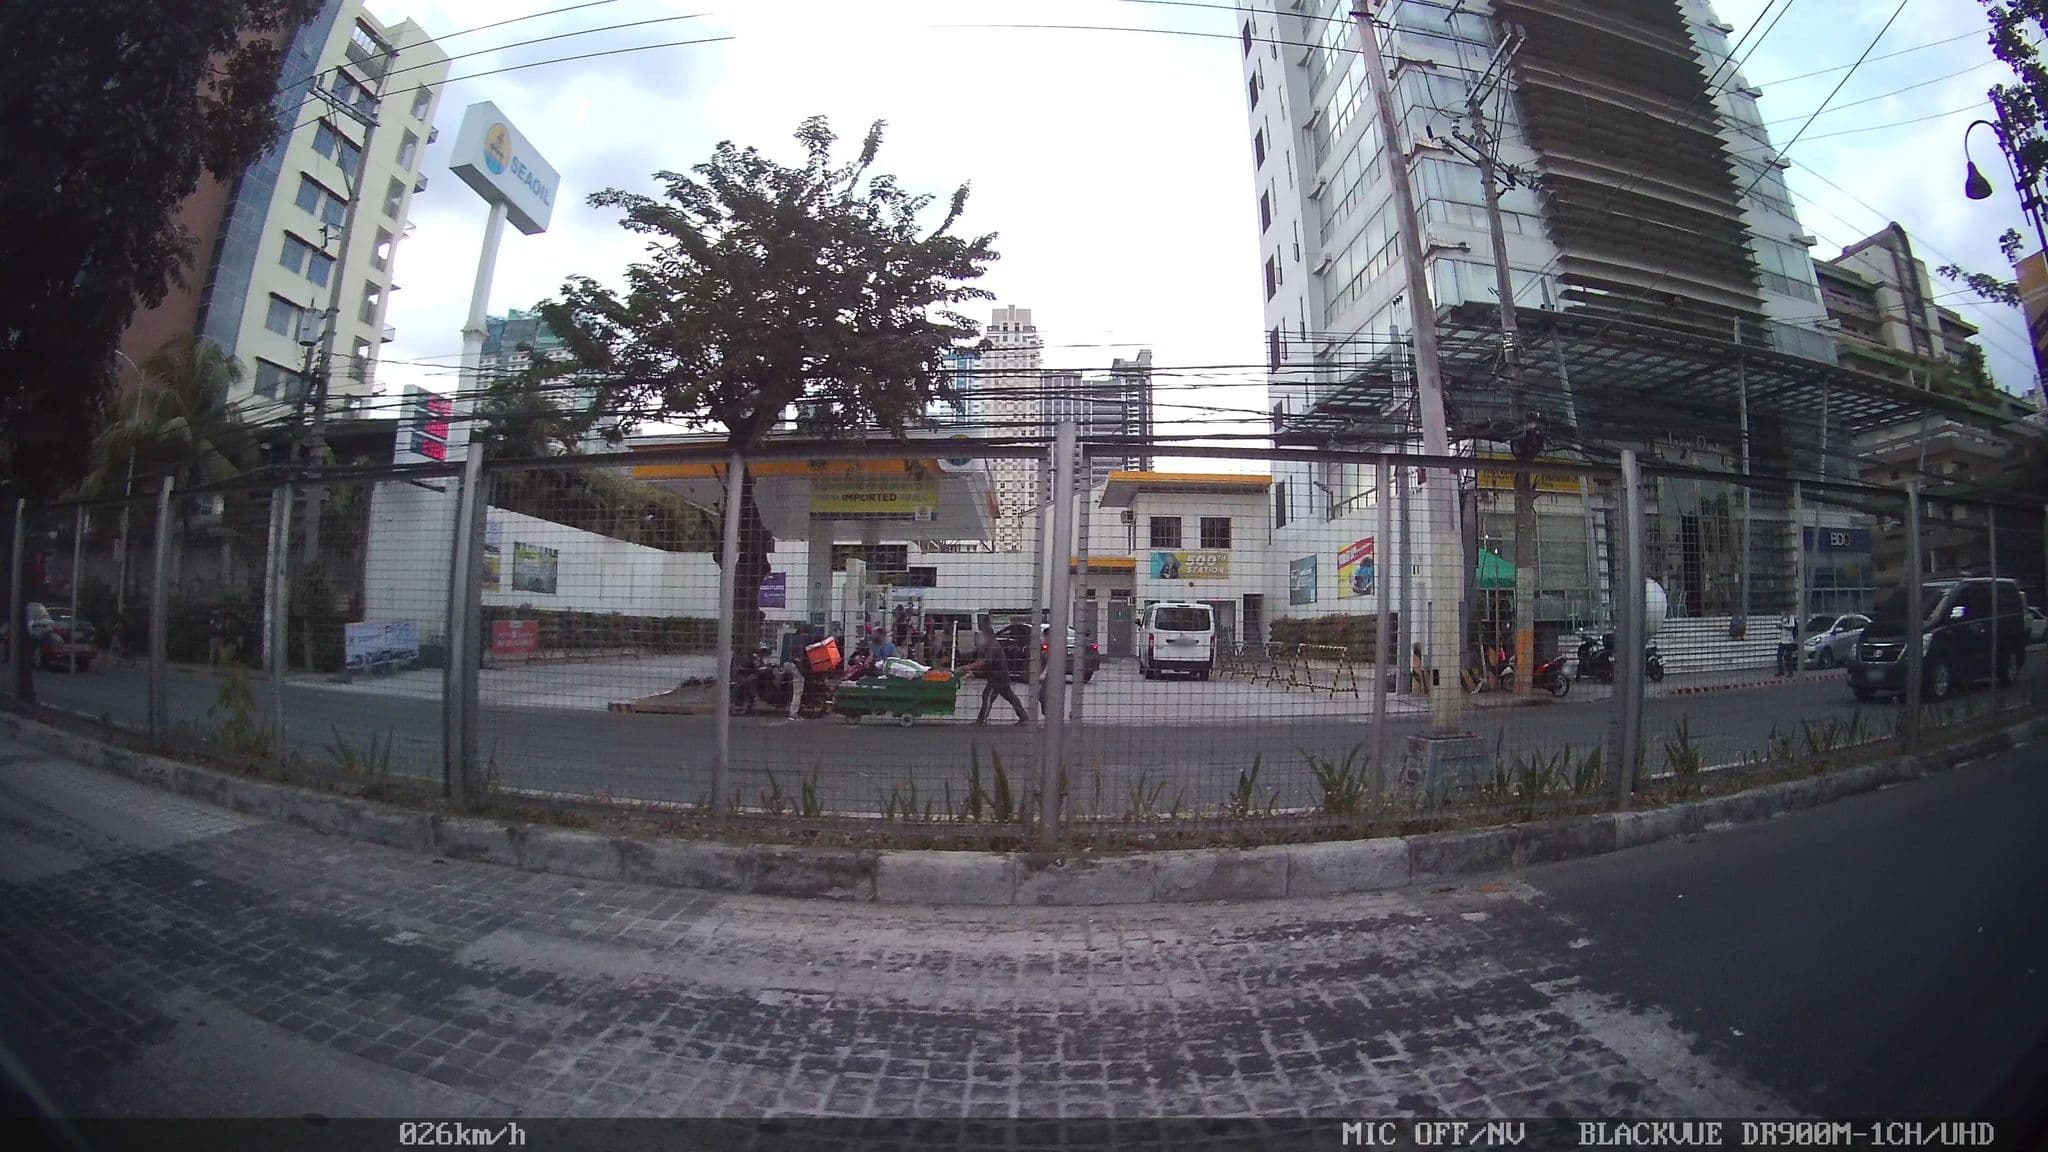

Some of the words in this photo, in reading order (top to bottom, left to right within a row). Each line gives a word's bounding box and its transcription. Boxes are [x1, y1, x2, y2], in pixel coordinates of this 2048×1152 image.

[511, 156, 550, 206] SEAOIL
[842, 493, 897, 502] IMPORTED
[1186, 566, 1225, 574] STATION
